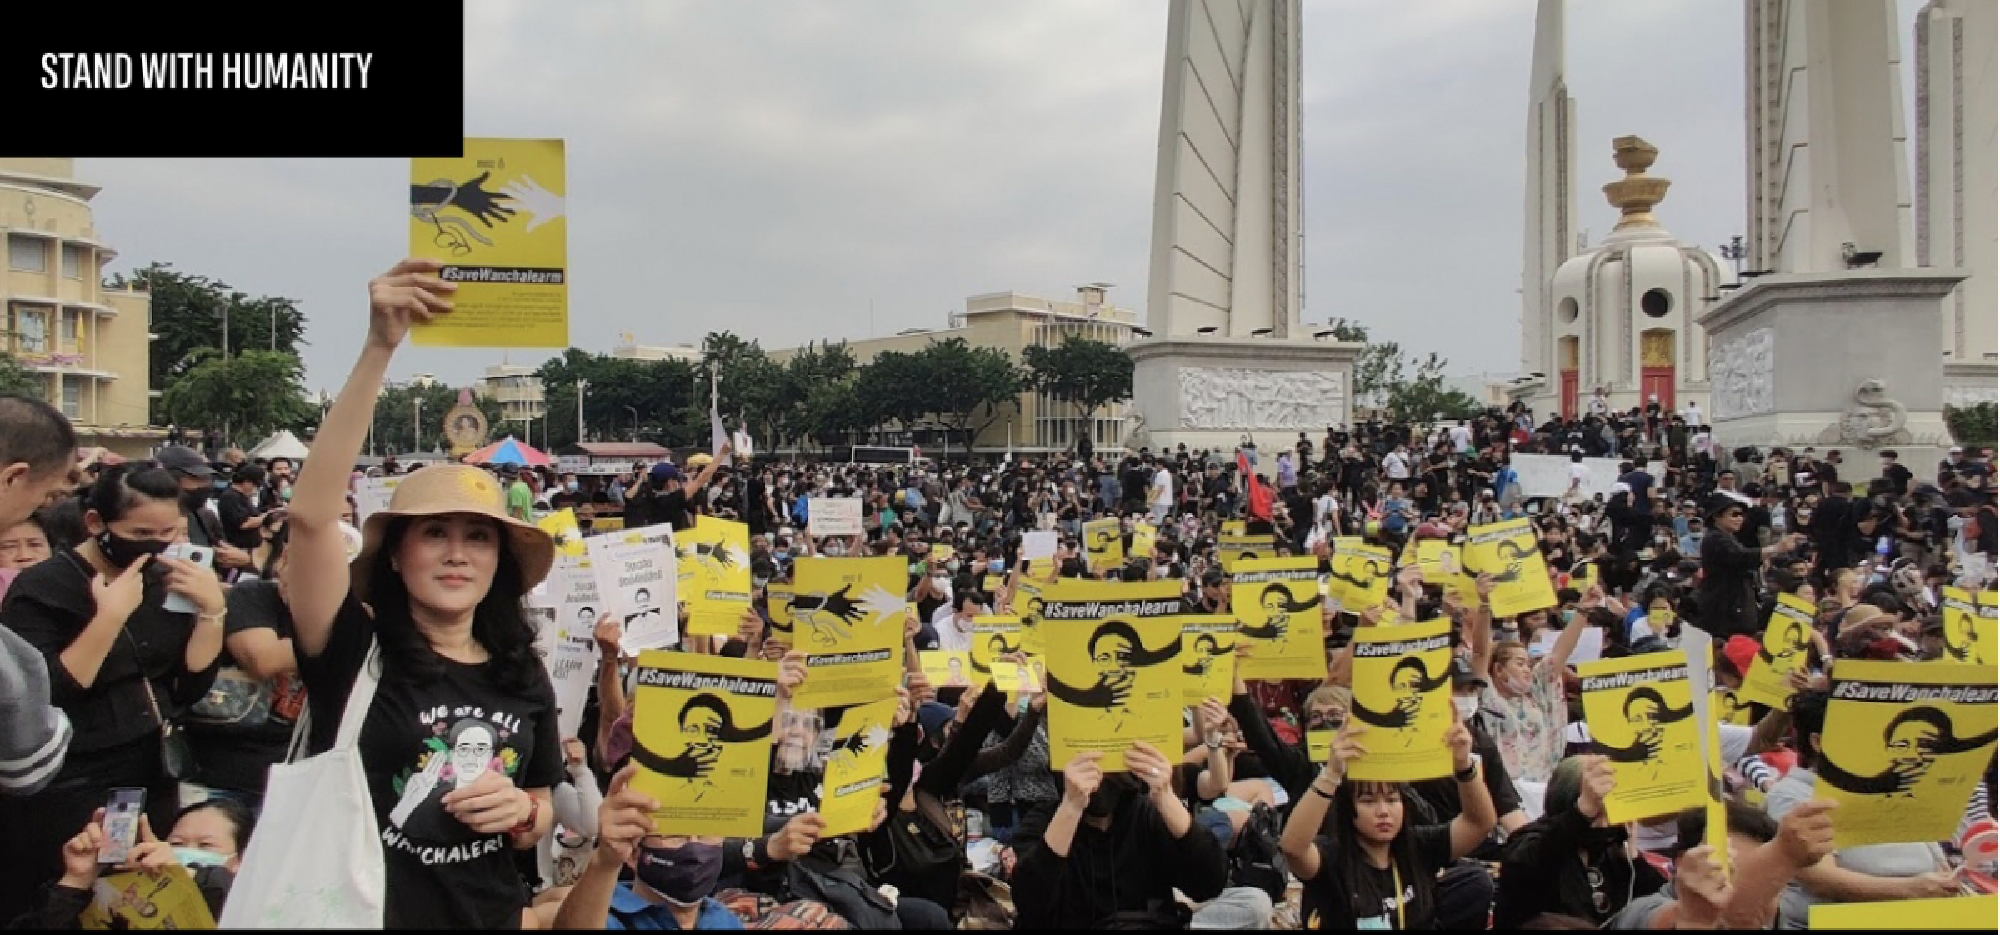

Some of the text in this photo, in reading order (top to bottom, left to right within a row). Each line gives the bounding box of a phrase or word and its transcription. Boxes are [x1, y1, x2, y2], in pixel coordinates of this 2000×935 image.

[441, 267, 562, 283] #SaveWanchalearm
[1044, 599, 1181, 618] #SaveWanchalearm
[638, 668, 776, 697] #SaveWanchalearm
[1832, 682, 1998, 703] #SaveWanchalear
[453, 705, 485, 719] are
[491, 711, 521, 734] all
